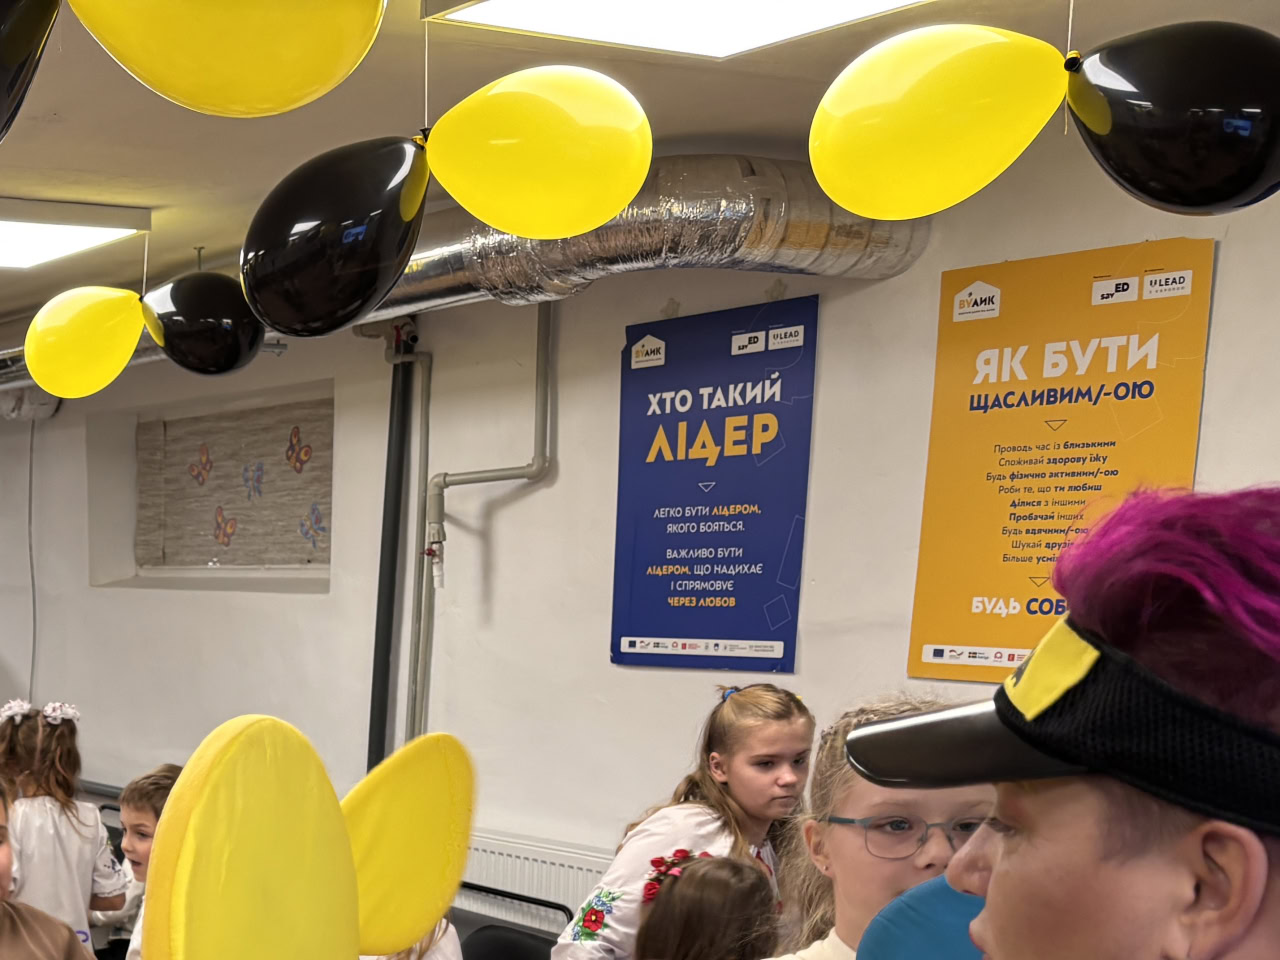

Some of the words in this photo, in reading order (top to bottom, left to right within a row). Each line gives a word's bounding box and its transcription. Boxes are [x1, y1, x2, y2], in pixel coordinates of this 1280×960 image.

[972, 345, 1029, 385] ЯК
[1042, 332, 1160, 379] БУТИ
[646, 389, 693, 416] ХТО
[698, 371, 782, 410] ТАКИЙ
[968, 379, 1155, 414] ЩАСЛИВИМ/-ОЮ
[645, 412, 779, 467] ЛІДЕР
[993, 444, 1033, 455] Проводь
[1035, 443, 1051, 451] час
[1053, 442, 1061, 450] із
[1063, 440, 1117, 450] близькими
[998, 456, 1044, 467] Споживай
[1046, 455, 1087, 465] здорову
[1089, 453, 1108, 464] їжу
[986, 472, 1007, 483] Будь
[1009, 470, 1046, 482] фізично
[1048, 467, 1119, 479] активним/-ою
[998, 485, 1021, 494] Роби
[1037, 486, 1051, 494] що
[1067, 483, 1102, 492] любиш
[1009, 499, 1042, 508] Ділися
[1051, 498, 1086, 507] іншими
[653, 506, 683, 518] ЛЕГКО
[685, 506, 710, 517] БУТИ
[1009, 511, 1055, 523] Пробачай
[1057, 511, 1084, 521] інших
[666, 522, 697, 534] ЯКОГО
[699, 521, 745, 533] БОЯТЬСЯ.
[1001, 525, 1023, 537] Будь
[1011, 539, 1042, 551] Шукай
[666, 548, 715, 559] ВАЖЛИВО
[717, 547, 743, 558] БУТИ
[1002, 553, 1033, 563] Більше
[693, 564, 711, 576] ЩО
[713, 563, 763, 576] НАДИХАЄ
[676, 580, 735, 591] СПРЯМОВУЄ
[667, 596, 697, 607] ЧЕРЕЗ
[698, 596, 736, 607] ЛЮБОВ
[971, 596, 1022, 618] БУДЬ
[1026, 598, 1066, 616] СОБ
